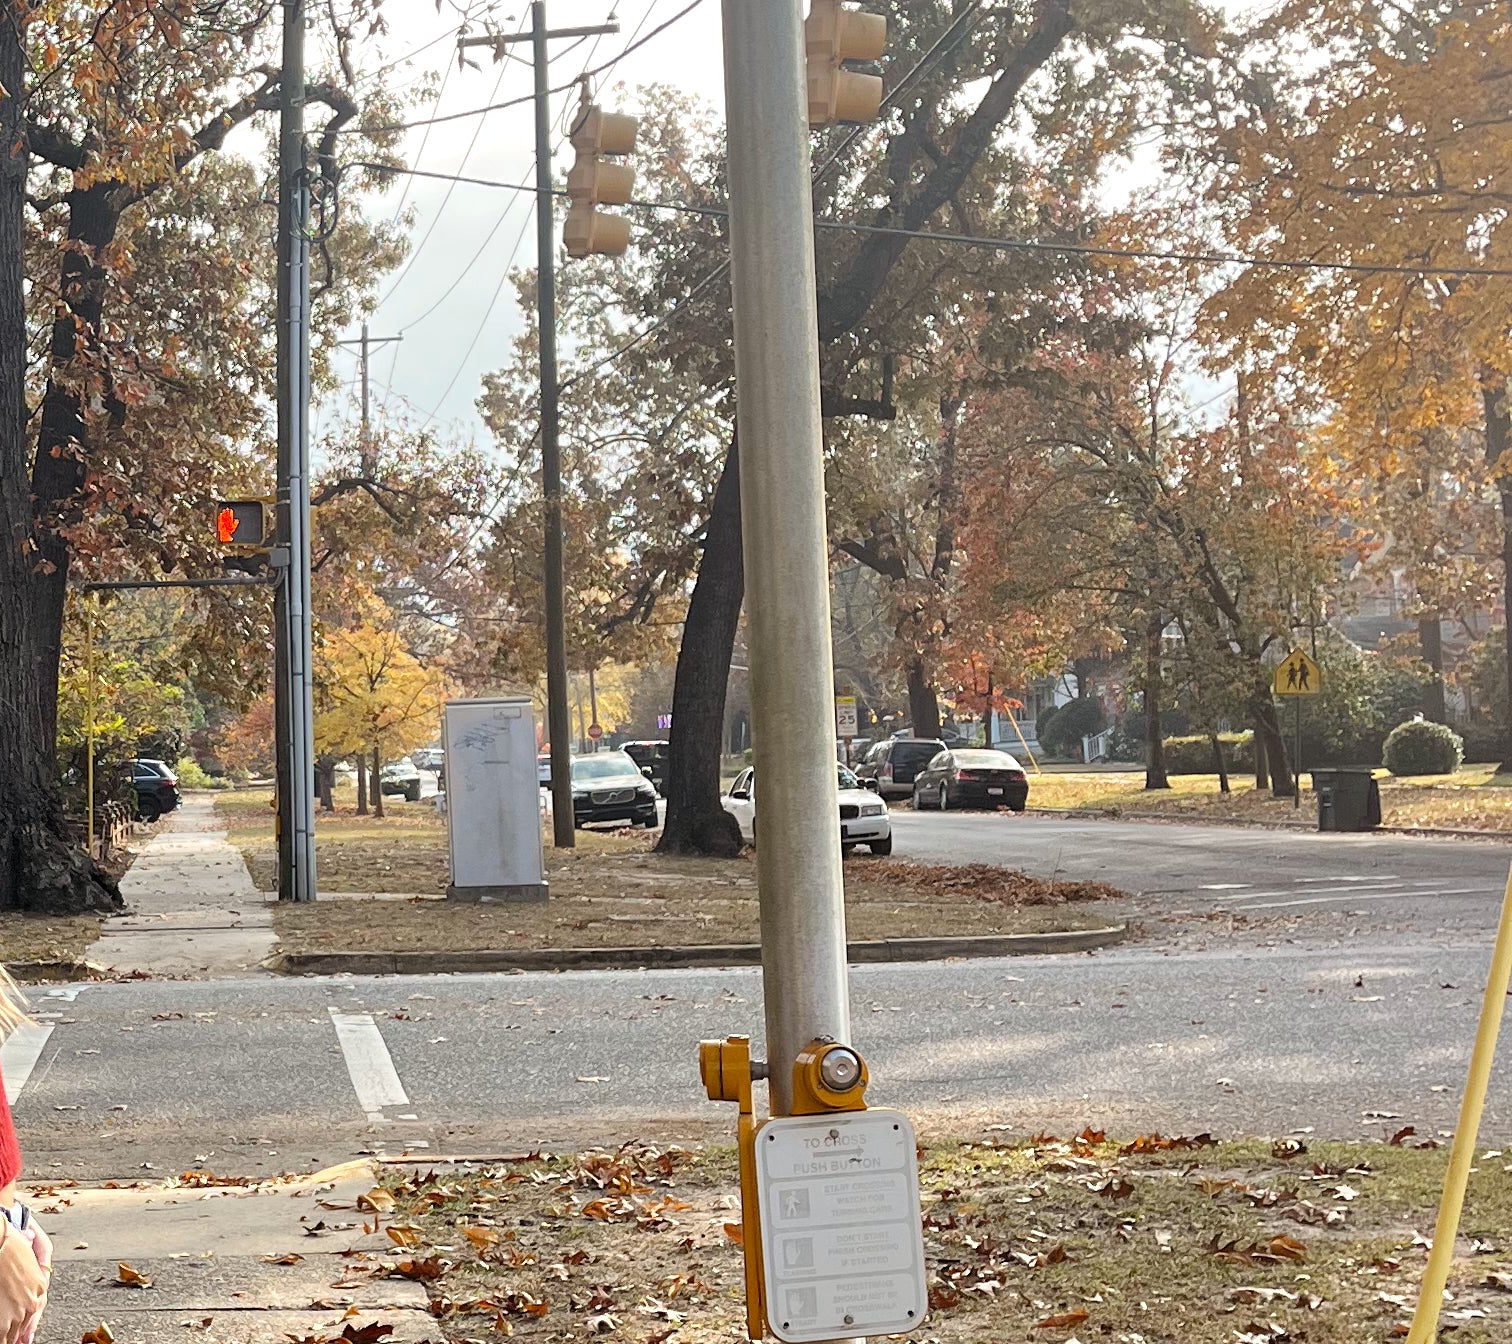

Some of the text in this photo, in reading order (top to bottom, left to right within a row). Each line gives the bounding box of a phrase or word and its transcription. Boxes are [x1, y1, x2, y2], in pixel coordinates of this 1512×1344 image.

[839, 716, 855, 725] 25
[803, 1134, 867, 1148] TO CROSS
[793, 1161, 827, 1174] PUSH
